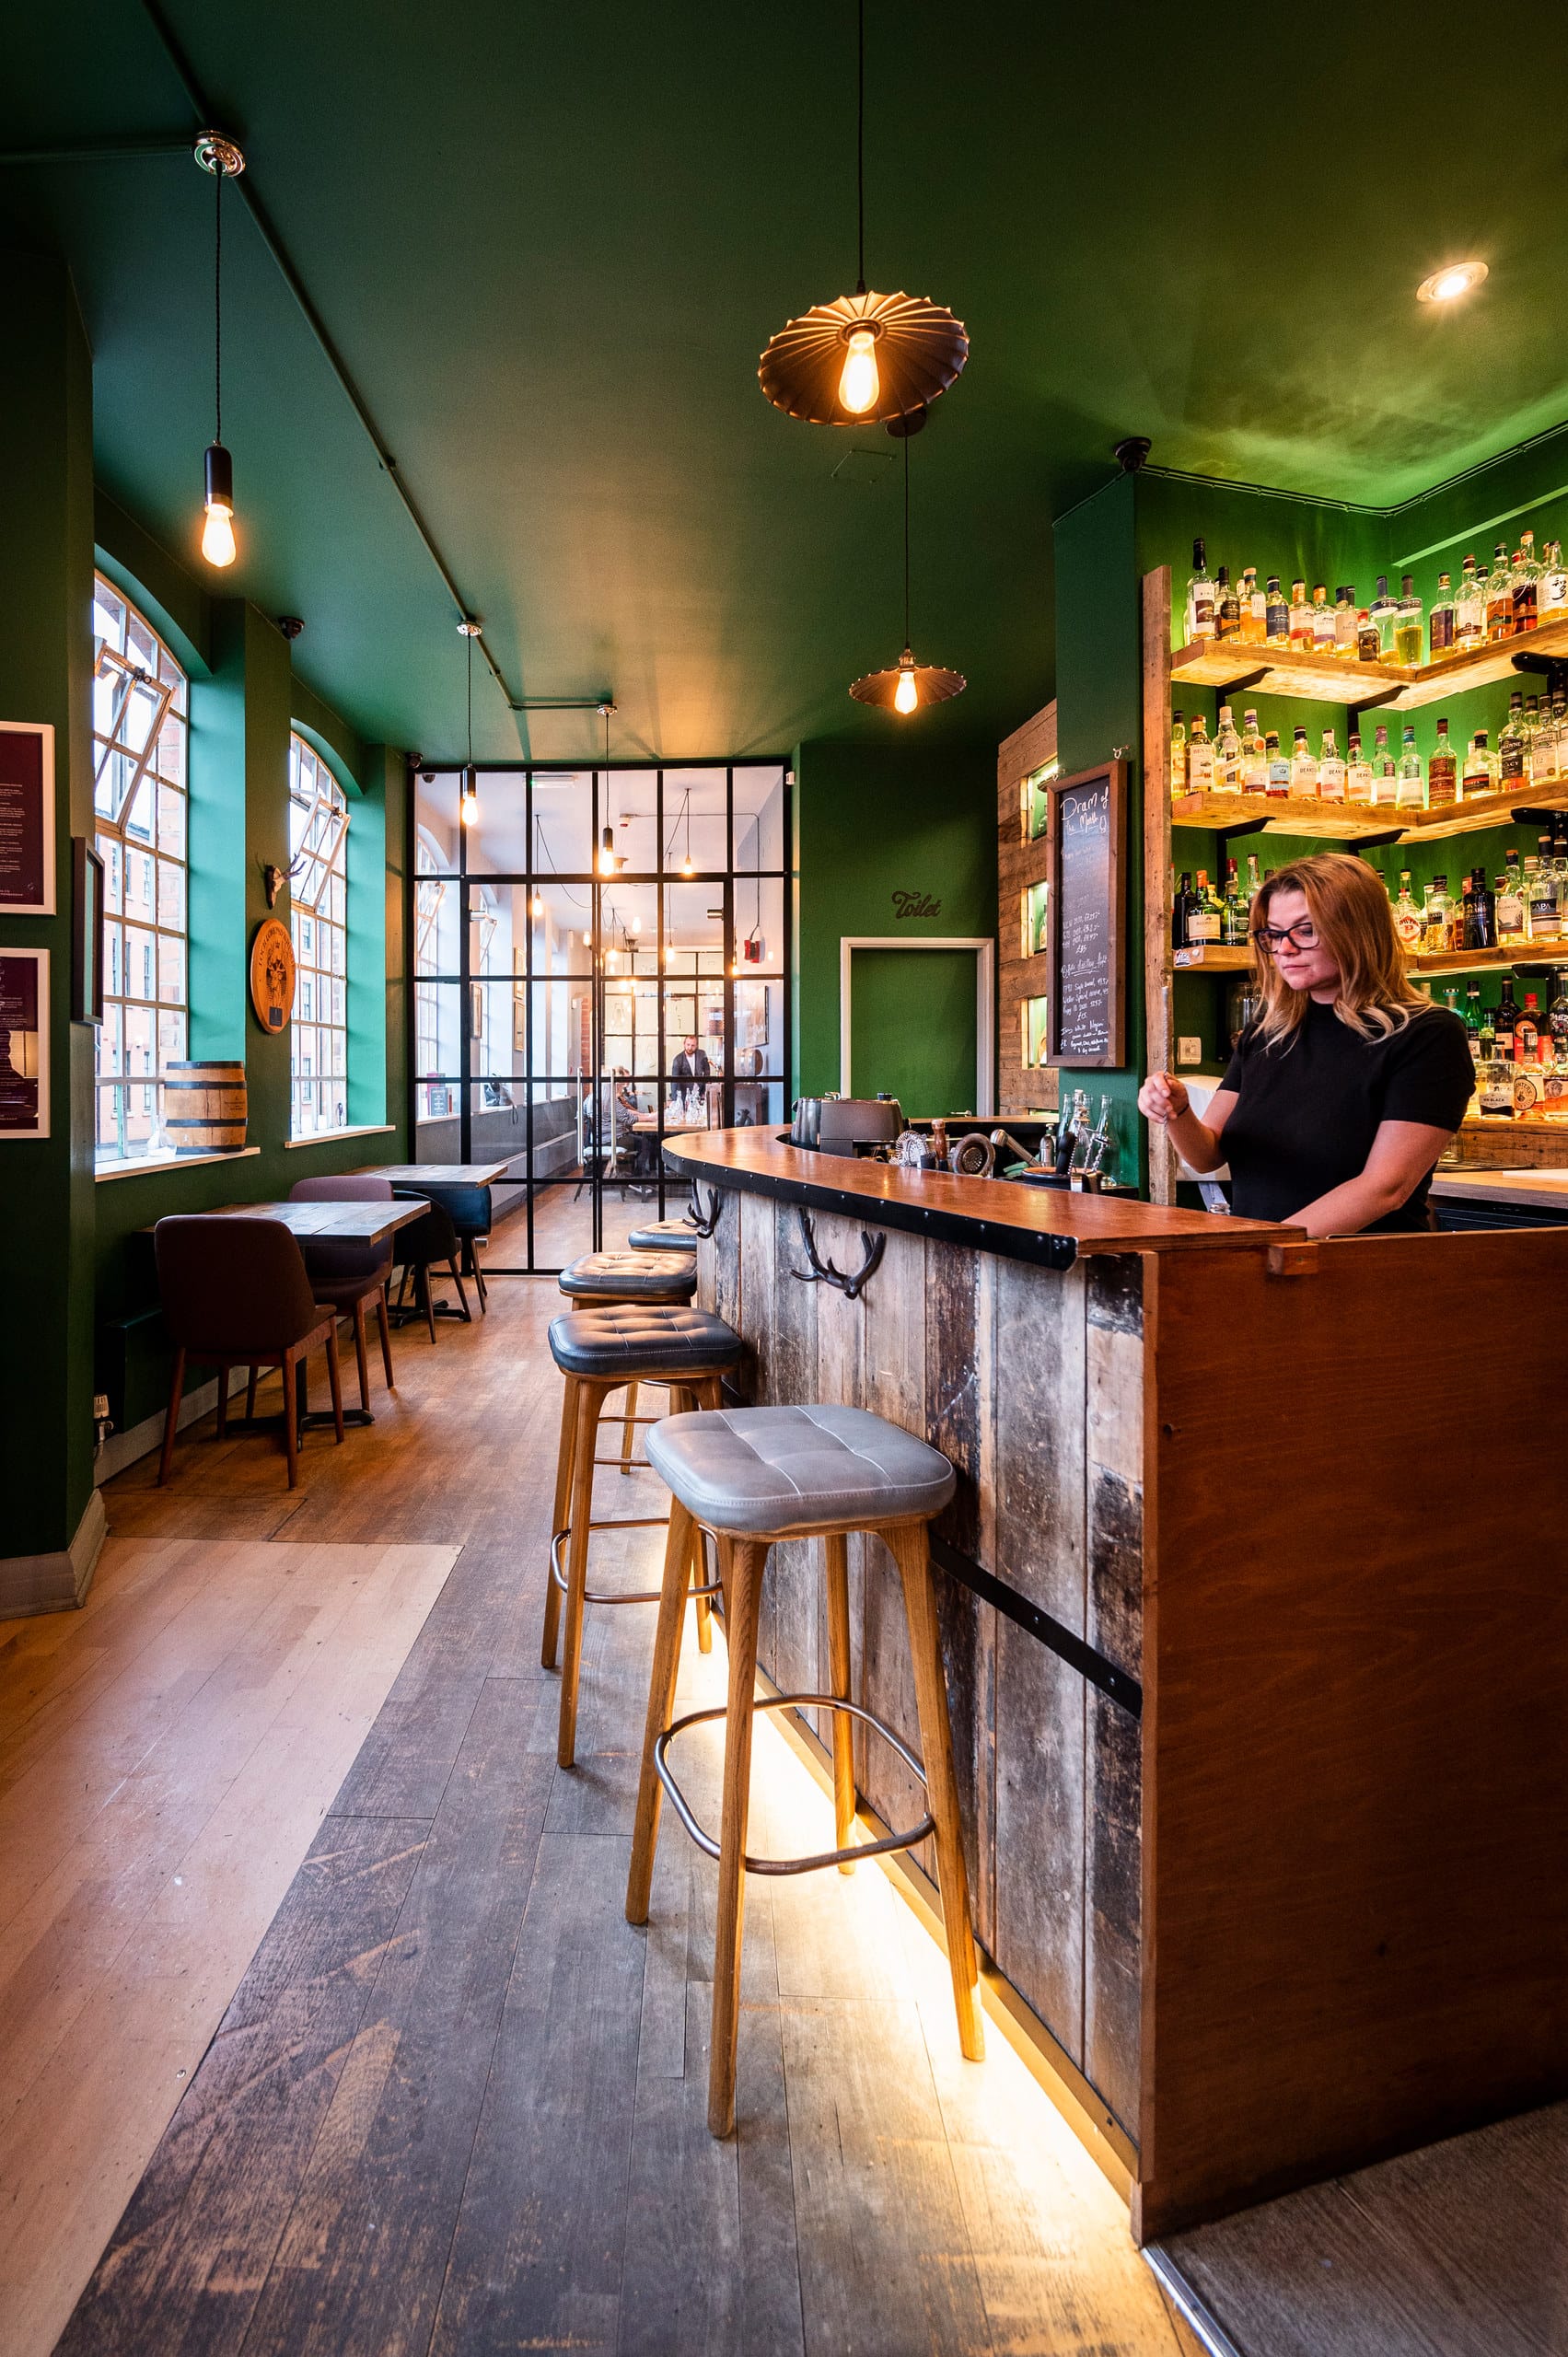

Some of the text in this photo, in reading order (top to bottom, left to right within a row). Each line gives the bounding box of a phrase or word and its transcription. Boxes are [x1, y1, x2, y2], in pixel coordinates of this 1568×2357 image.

[1060, 785, 1109, 821] Dram of
[891, 890, 943, 920] Toilet
